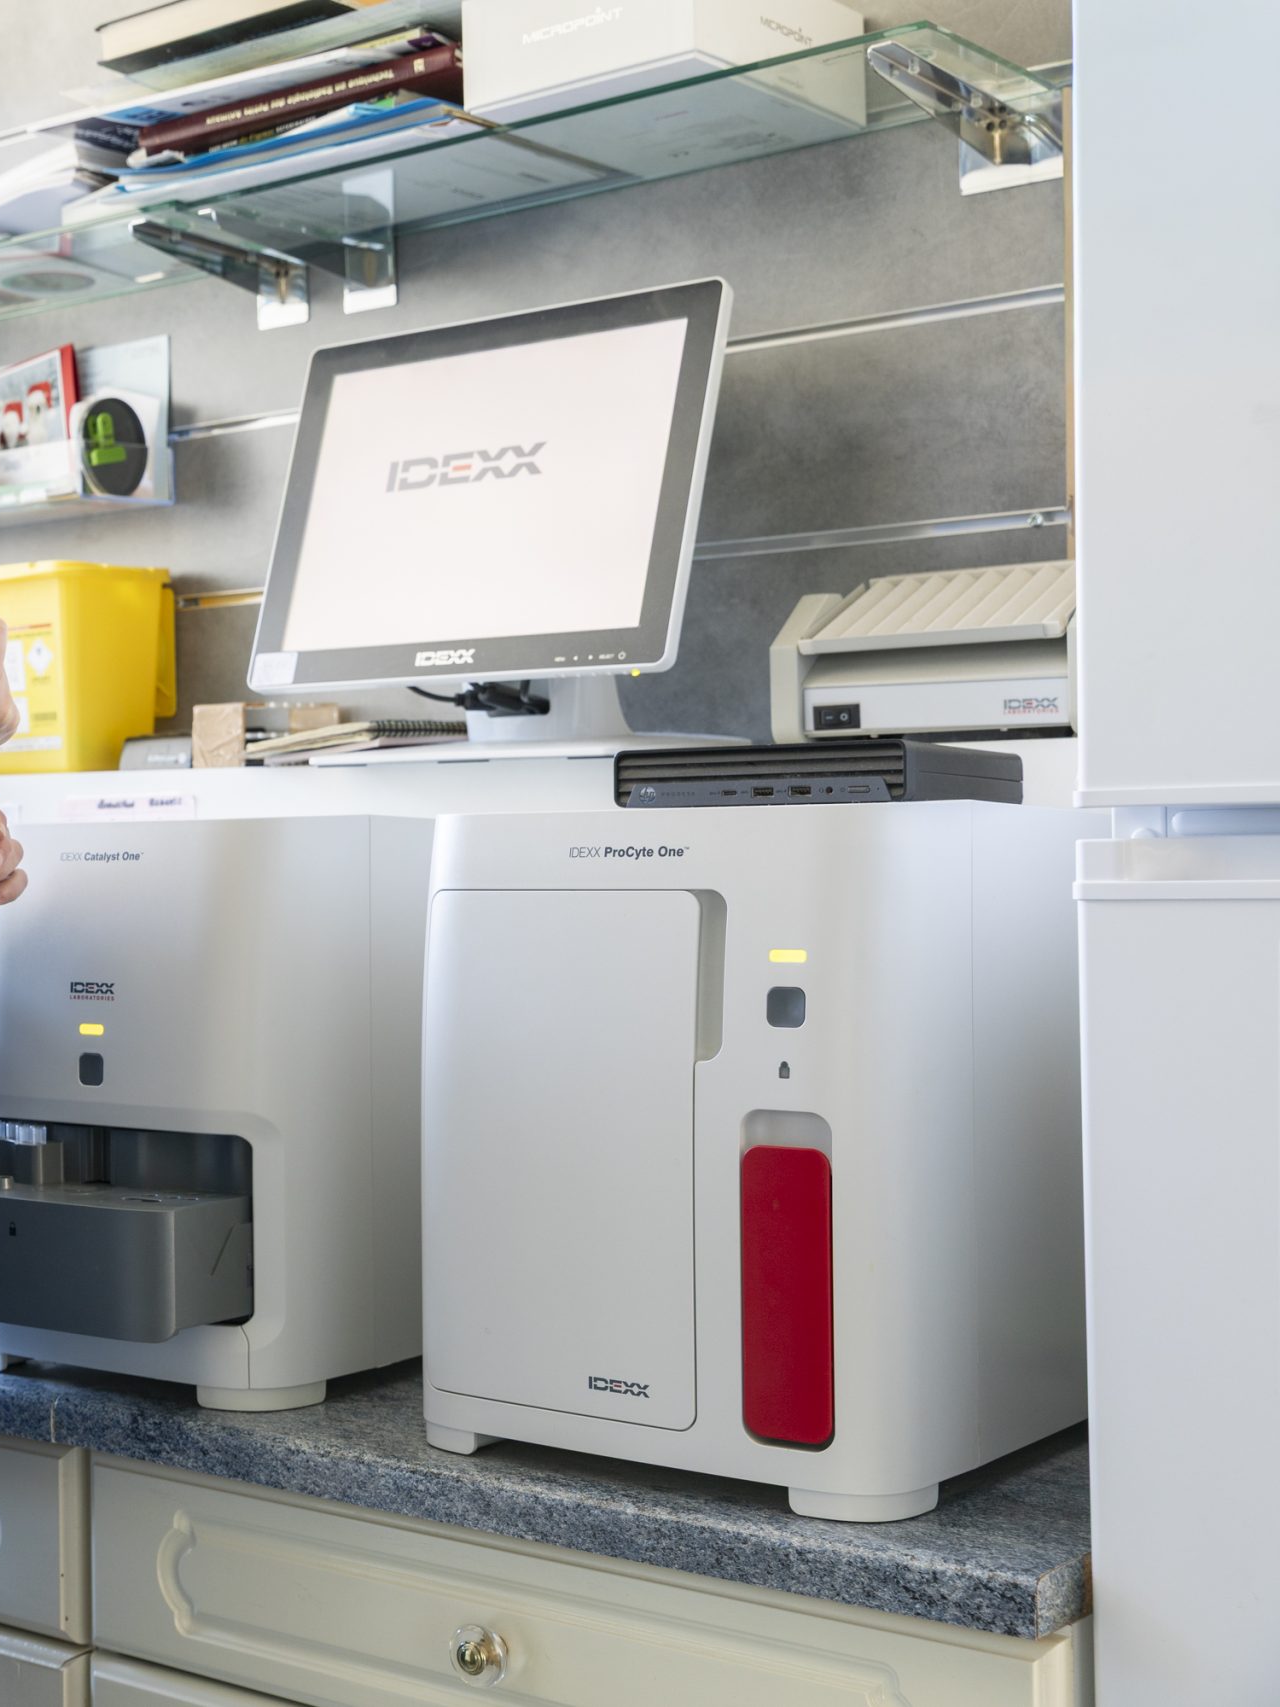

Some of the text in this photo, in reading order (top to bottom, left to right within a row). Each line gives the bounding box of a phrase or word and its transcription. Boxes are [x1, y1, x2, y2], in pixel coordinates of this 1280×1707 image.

[522, 7, 623, 45] MICROPOINT
[759, 15, 813, 48] MICROPOINT
[347, 68, 395, 90] Technique
[286, 85, 334, 105] Radiologie
[385, 440, 548, 493] IDEXX
[414, 648, 476, 667] IDEXX
[1003, 697, 1059, 710] IDEXX
[84, 851, 120, 863] Catalyst
[568, 847, 601, 858] IDEXX
[603, 846, 654, 860] ProCyte
[70, 982, 115, 994] IDEXX
[588, 1375, 650, 1399] IDEXX
